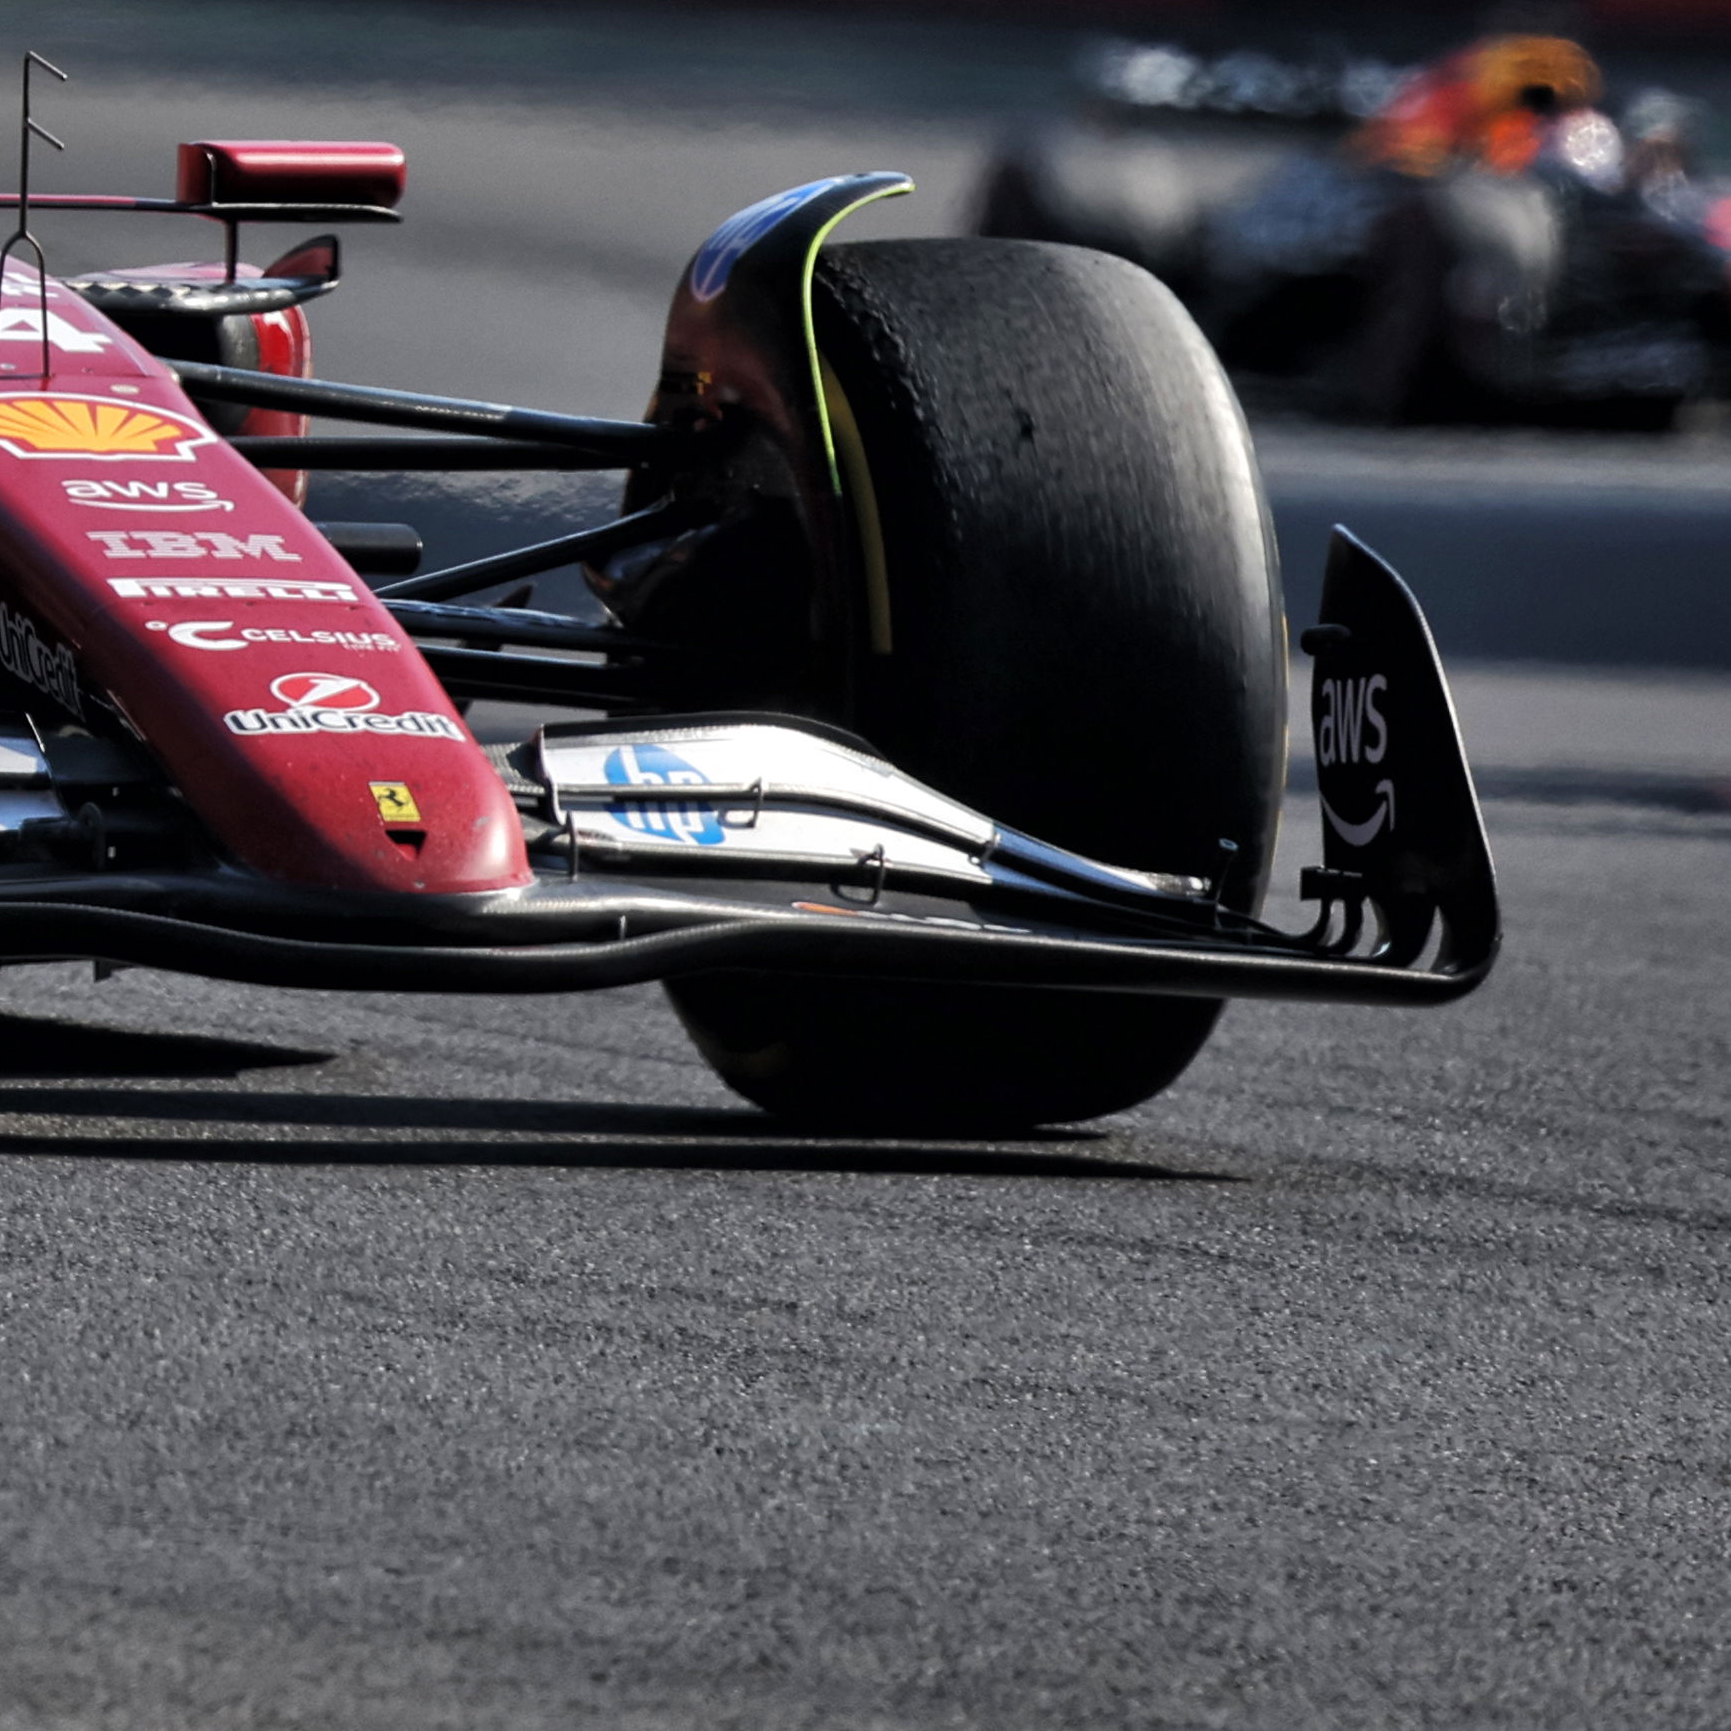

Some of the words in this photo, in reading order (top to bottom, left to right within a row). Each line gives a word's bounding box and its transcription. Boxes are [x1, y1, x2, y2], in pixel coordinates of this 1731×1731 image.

[61, 479, 218, 500] aws
[85, 531, 302, 562] IBM
[106, 577, 360, 602] PIRELLI
[240, 629, 397, 647] CELSIUS
[223, 708, 468, 743] UniCredit
[1320, 673, 1388, 767] aws
[618, 744, 706, 846] hp
